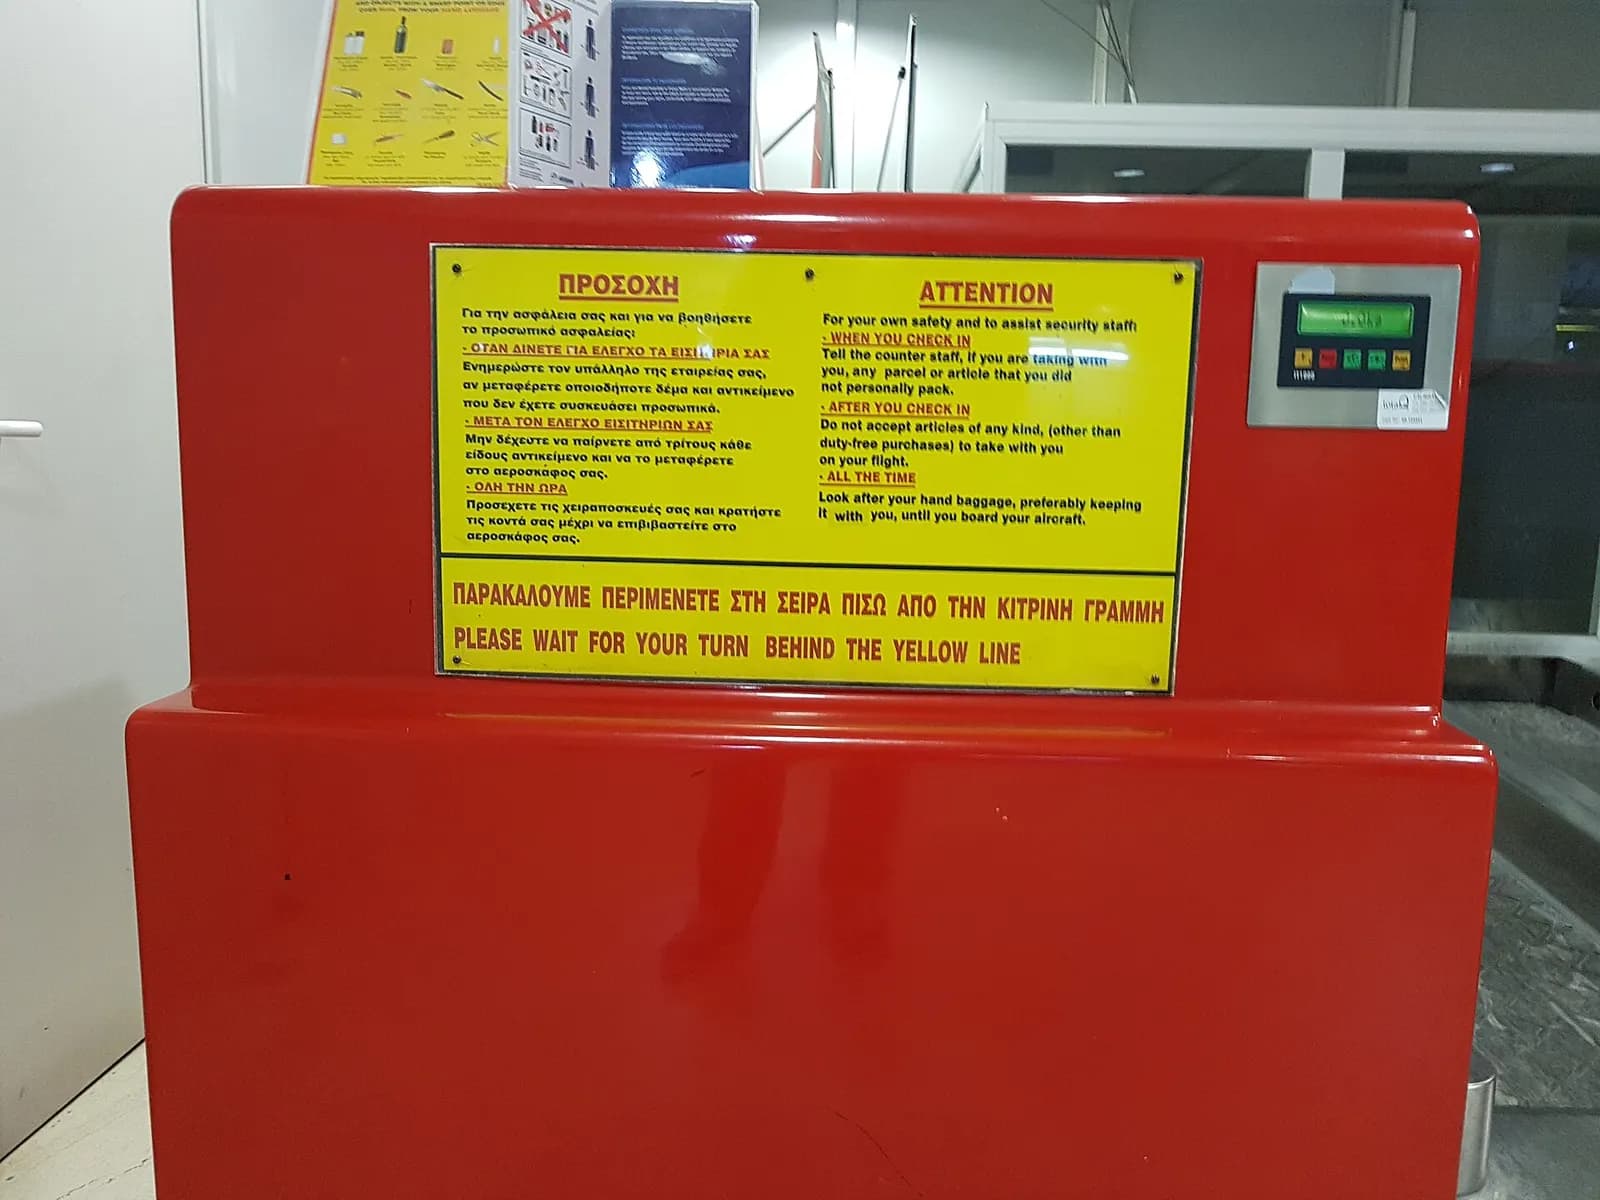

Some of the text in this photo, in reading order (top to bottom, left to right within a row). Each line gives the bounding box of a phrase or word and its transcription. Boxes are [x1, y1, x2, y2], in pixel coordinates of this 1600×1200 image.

[560, 274, 678, 295] ΠΡΟΣΟΧΗ
[920, 281, 1052, 304] ATTENTION
[462, 308, 481, 317] Για
[486, 311, 508, 320] την
[581, 313, 605, 323] σας
[610, 313, 629, 321] και
[634, 314, 653, 323] για
[824, 313, 844, 325] For
[848, 316, 876, 328] your
[881, 317, 907, 326] own
[912, 315, 951, 330] safety
[956, 317, 980, 328] and
[985, 317, 997, 328] to
[1002, 318, 1041, 329] assist
[1046, 319, 1098, 333] security
[462, 326, 477, 334] το
[831, 332, 952, 346] WHEN YOU CHECK
[513, 344, 562, 354] ΔΙΝΕΤΕ
[567, 345, 585, 355] ΓΙΑ
[592, 345, 645, 356] ΕΛΕΓΧΟ
[743, 348, 770, 359] ΣΑΣ
[822, 348, 845, 359] Tell
[850, 349, 871, 360] the
[875, 351, 926, 361] counter
[980, 354, 1002, 366] you
[1007, 355, 1028, 364] are
[548, 365, 570, 373] τον
[644, 368, 666, 377] της
[853, 368, 876, 379] any
[885, 367, 926, 380] parcel
[948, 368, 989, 379] article
[994, 369, 1020, 380] that
[1025, 372, 1047, 383] you
[1052, 370, 1071, 381] did
[822, 381, 953, 397] not personally pack.
[463, 400, 488, 408] που
[493, 399, 515, 408] δεν
[829, 402, 952, 415] AFTER YOU CHECK
[473, 416, 713, 431] ΜΕΤΑ ΤΟΝ ΕΛΕΓΧΟ ΕΙΣΙΤΗΡΙΩΝ ΣΑΣ
[821, 419, 837, 430] Do
[842, 420, 862, 431] not
[867, 421, 911, 433] accept
[915, 421, 964, 433] articles
[985, 425, 1008, 436] any
[1092, 426, 1120, 437] than
[466, 434, 492, 446] Μην
[820, 437, 1063, 455] duty-free purchases) take with you
[820, 455, 908, 469] on your flight.
[466, 467, 607, 480] στο σας.
[825, 471, 915, 485] ALL THE TIME
[474, 481, 567, 493] ΟΛΗ ΤΗΝ ΩΡΑ
[819, 491, 849, 503] Look
[854, 492, 884, 504] after
[888, 496, 916, 506] your
[921, 494, 952, 505] hand
[1020, 497, 1085, 513] preferably
[1090, 498, 1141, 513] keeping
[666, 507, 690, 516] σας
[695, 507, 714, 515] και
[835, 510, 863, 522] with
[902, 509, 930, 520] until
[935, 513, 956, 524] you
[961, 511, 998, 522] board
[1002, 514, 1030, 525] your
[1034, 512, 1086, 525] aircraft.
[531, 519, 554, 528] σας
[713, 523, 736, 531] στο
[552, 535, 580, 544] σας.
[454, 582, 1164, 623] ΠΑΡΑΚΑΛΟΥΜΕ ΠΕΡΙΜΕΝΕΤΕ ΣΤΗ ΣΕΙΡΑ ΠΙΣΩ ΑΠΟ ΤΗΝ ΚΙΤΡΙΝΗ ΓΡΑΜΜΗ
[455, 627, 1020, 664] PLEASE WAIT FOR YOUR TURN BEHIND THE YELLOW LINE
